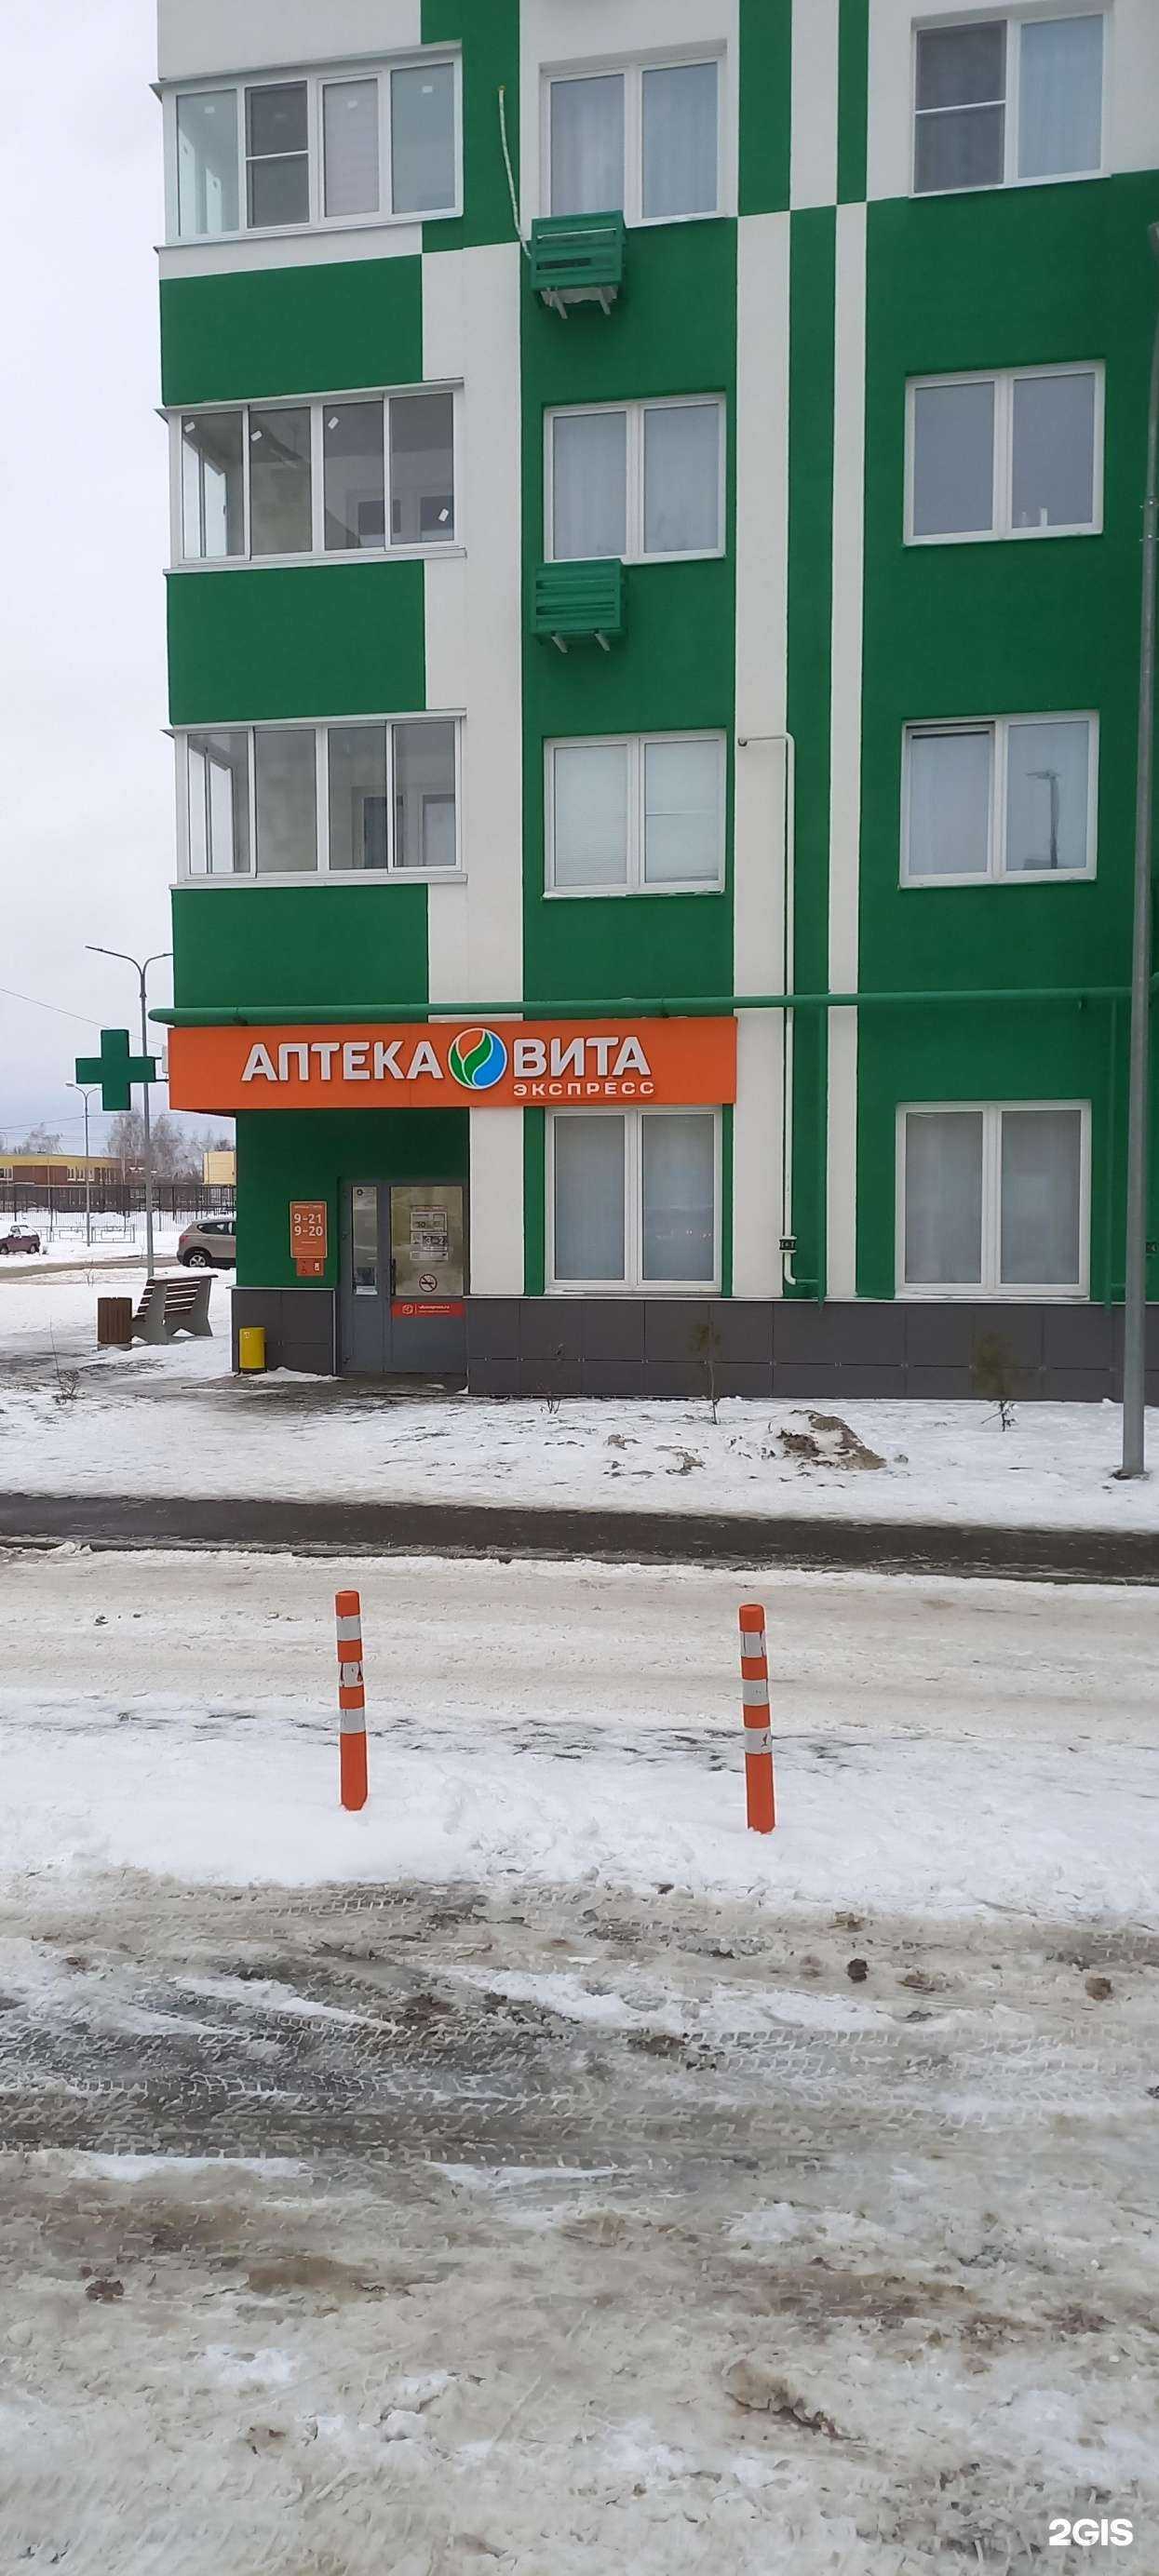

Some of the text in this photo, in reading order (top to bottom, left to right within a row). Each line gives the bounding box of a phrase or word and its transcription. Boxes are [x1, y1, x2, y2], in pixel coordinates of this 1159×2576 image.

[241, 1037, 652, 1081] АПТЕКА ВИТА
[514, 1082, 654, 1096] ЭКСПРЕСС
[293, 1213, 321, 1224] 9-21
[294, 1226, 323, 1236] 9-20
